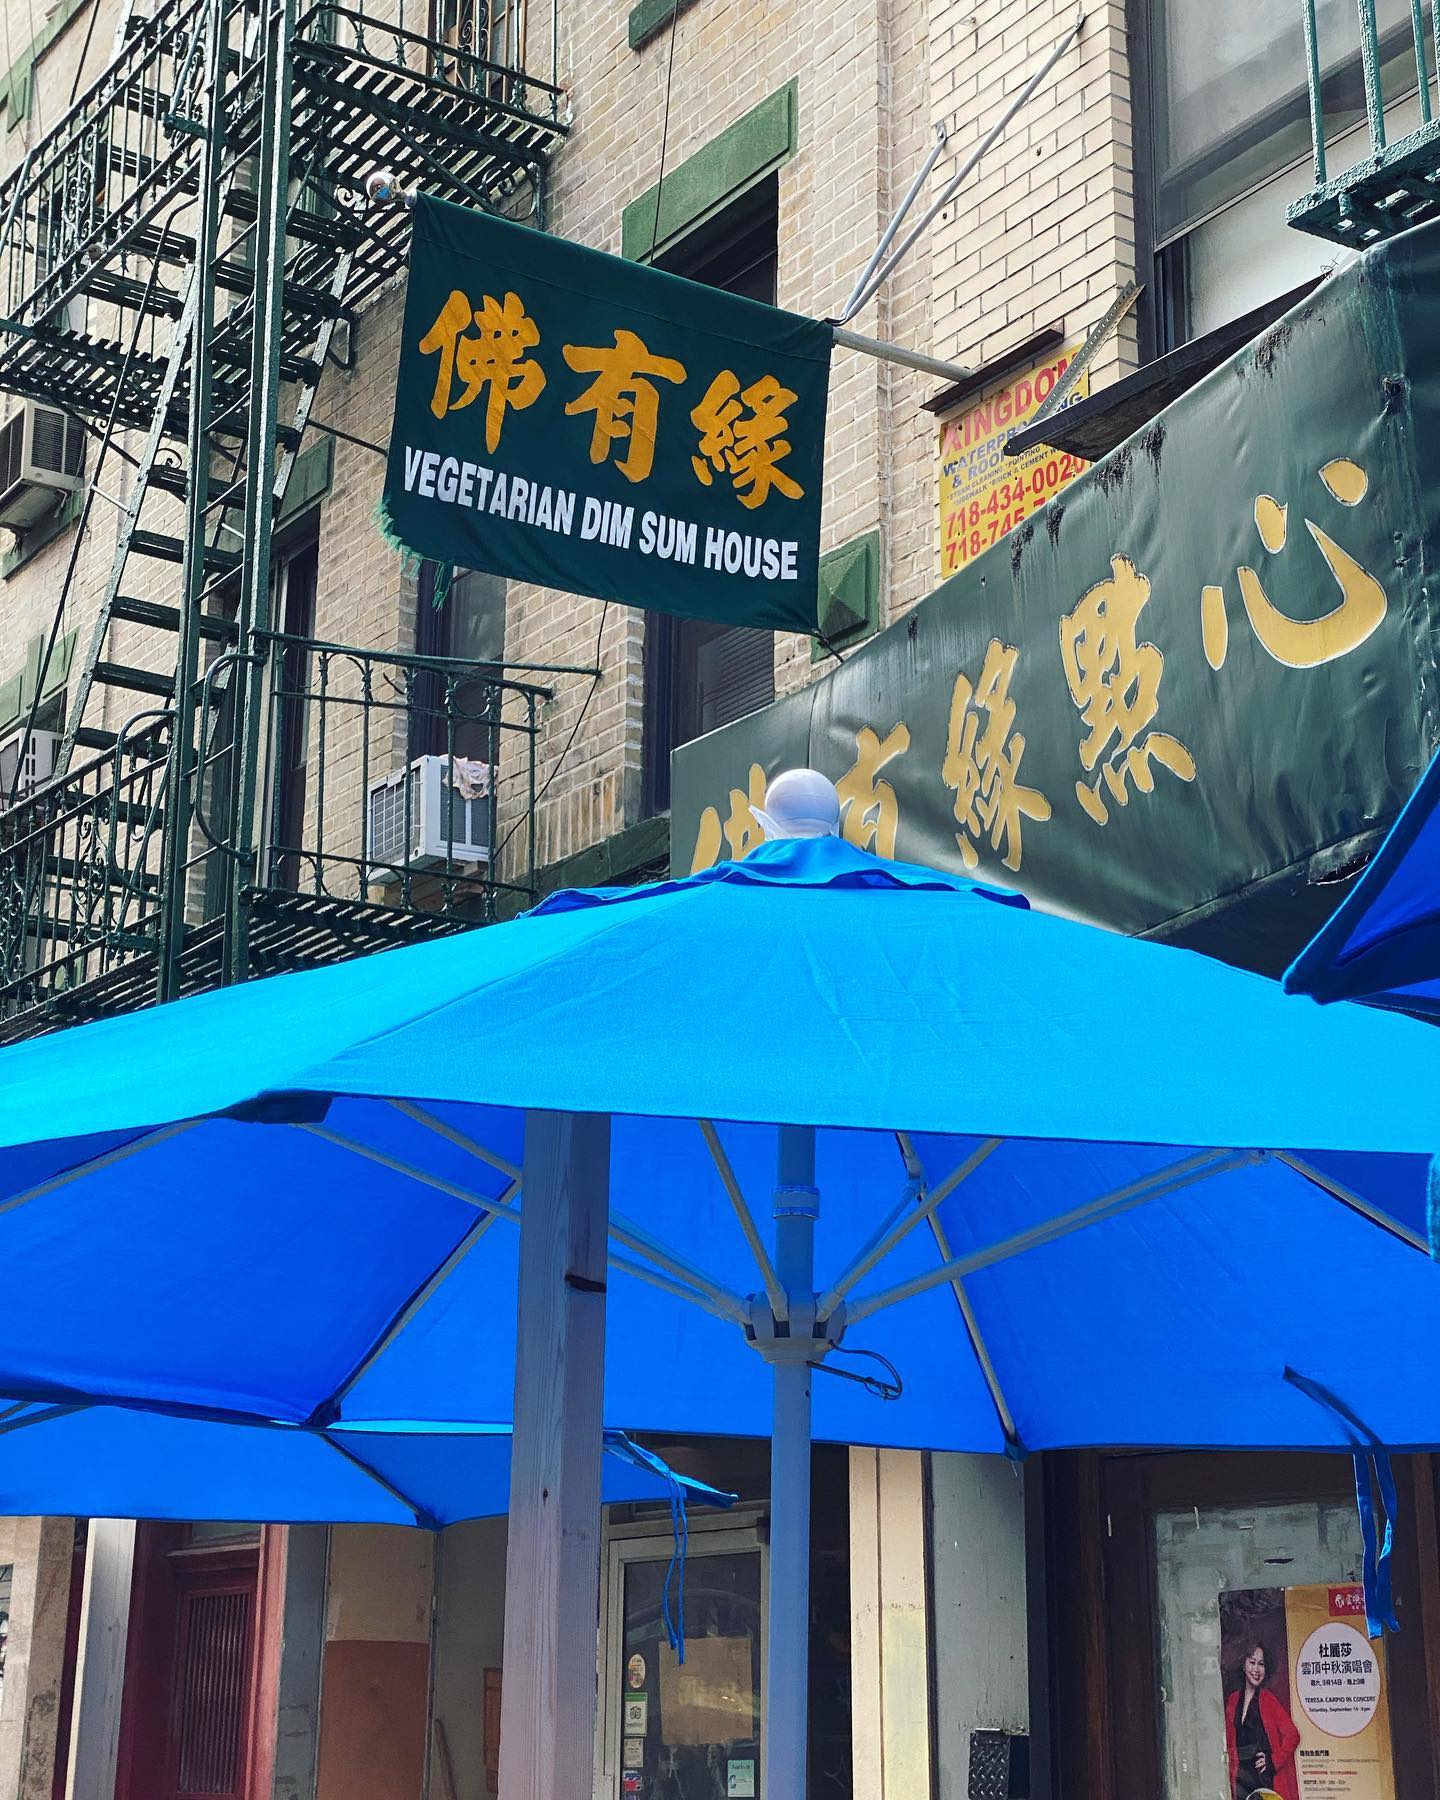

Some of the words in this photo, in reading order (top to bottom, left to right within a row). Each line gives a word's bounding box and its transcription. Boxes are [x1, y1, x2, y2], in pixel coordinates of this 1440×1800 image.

[419, 289, 805, 510] 佛有緣
[967, 450, 1005, 481] ROO
[1020, 453, 1049, 471] CEMENT
[404, 445, 577, 536] VEGETARIAN
[580, 497, 635, 549] DIM
[639, 510, 698, 565] SUM
[704, 527, 799, 580] HOUSE
[1301, 1660, 1373, 1675] 雲頂中秋演唱會
[1353, 1695, 1376, 1703] CONCERT
